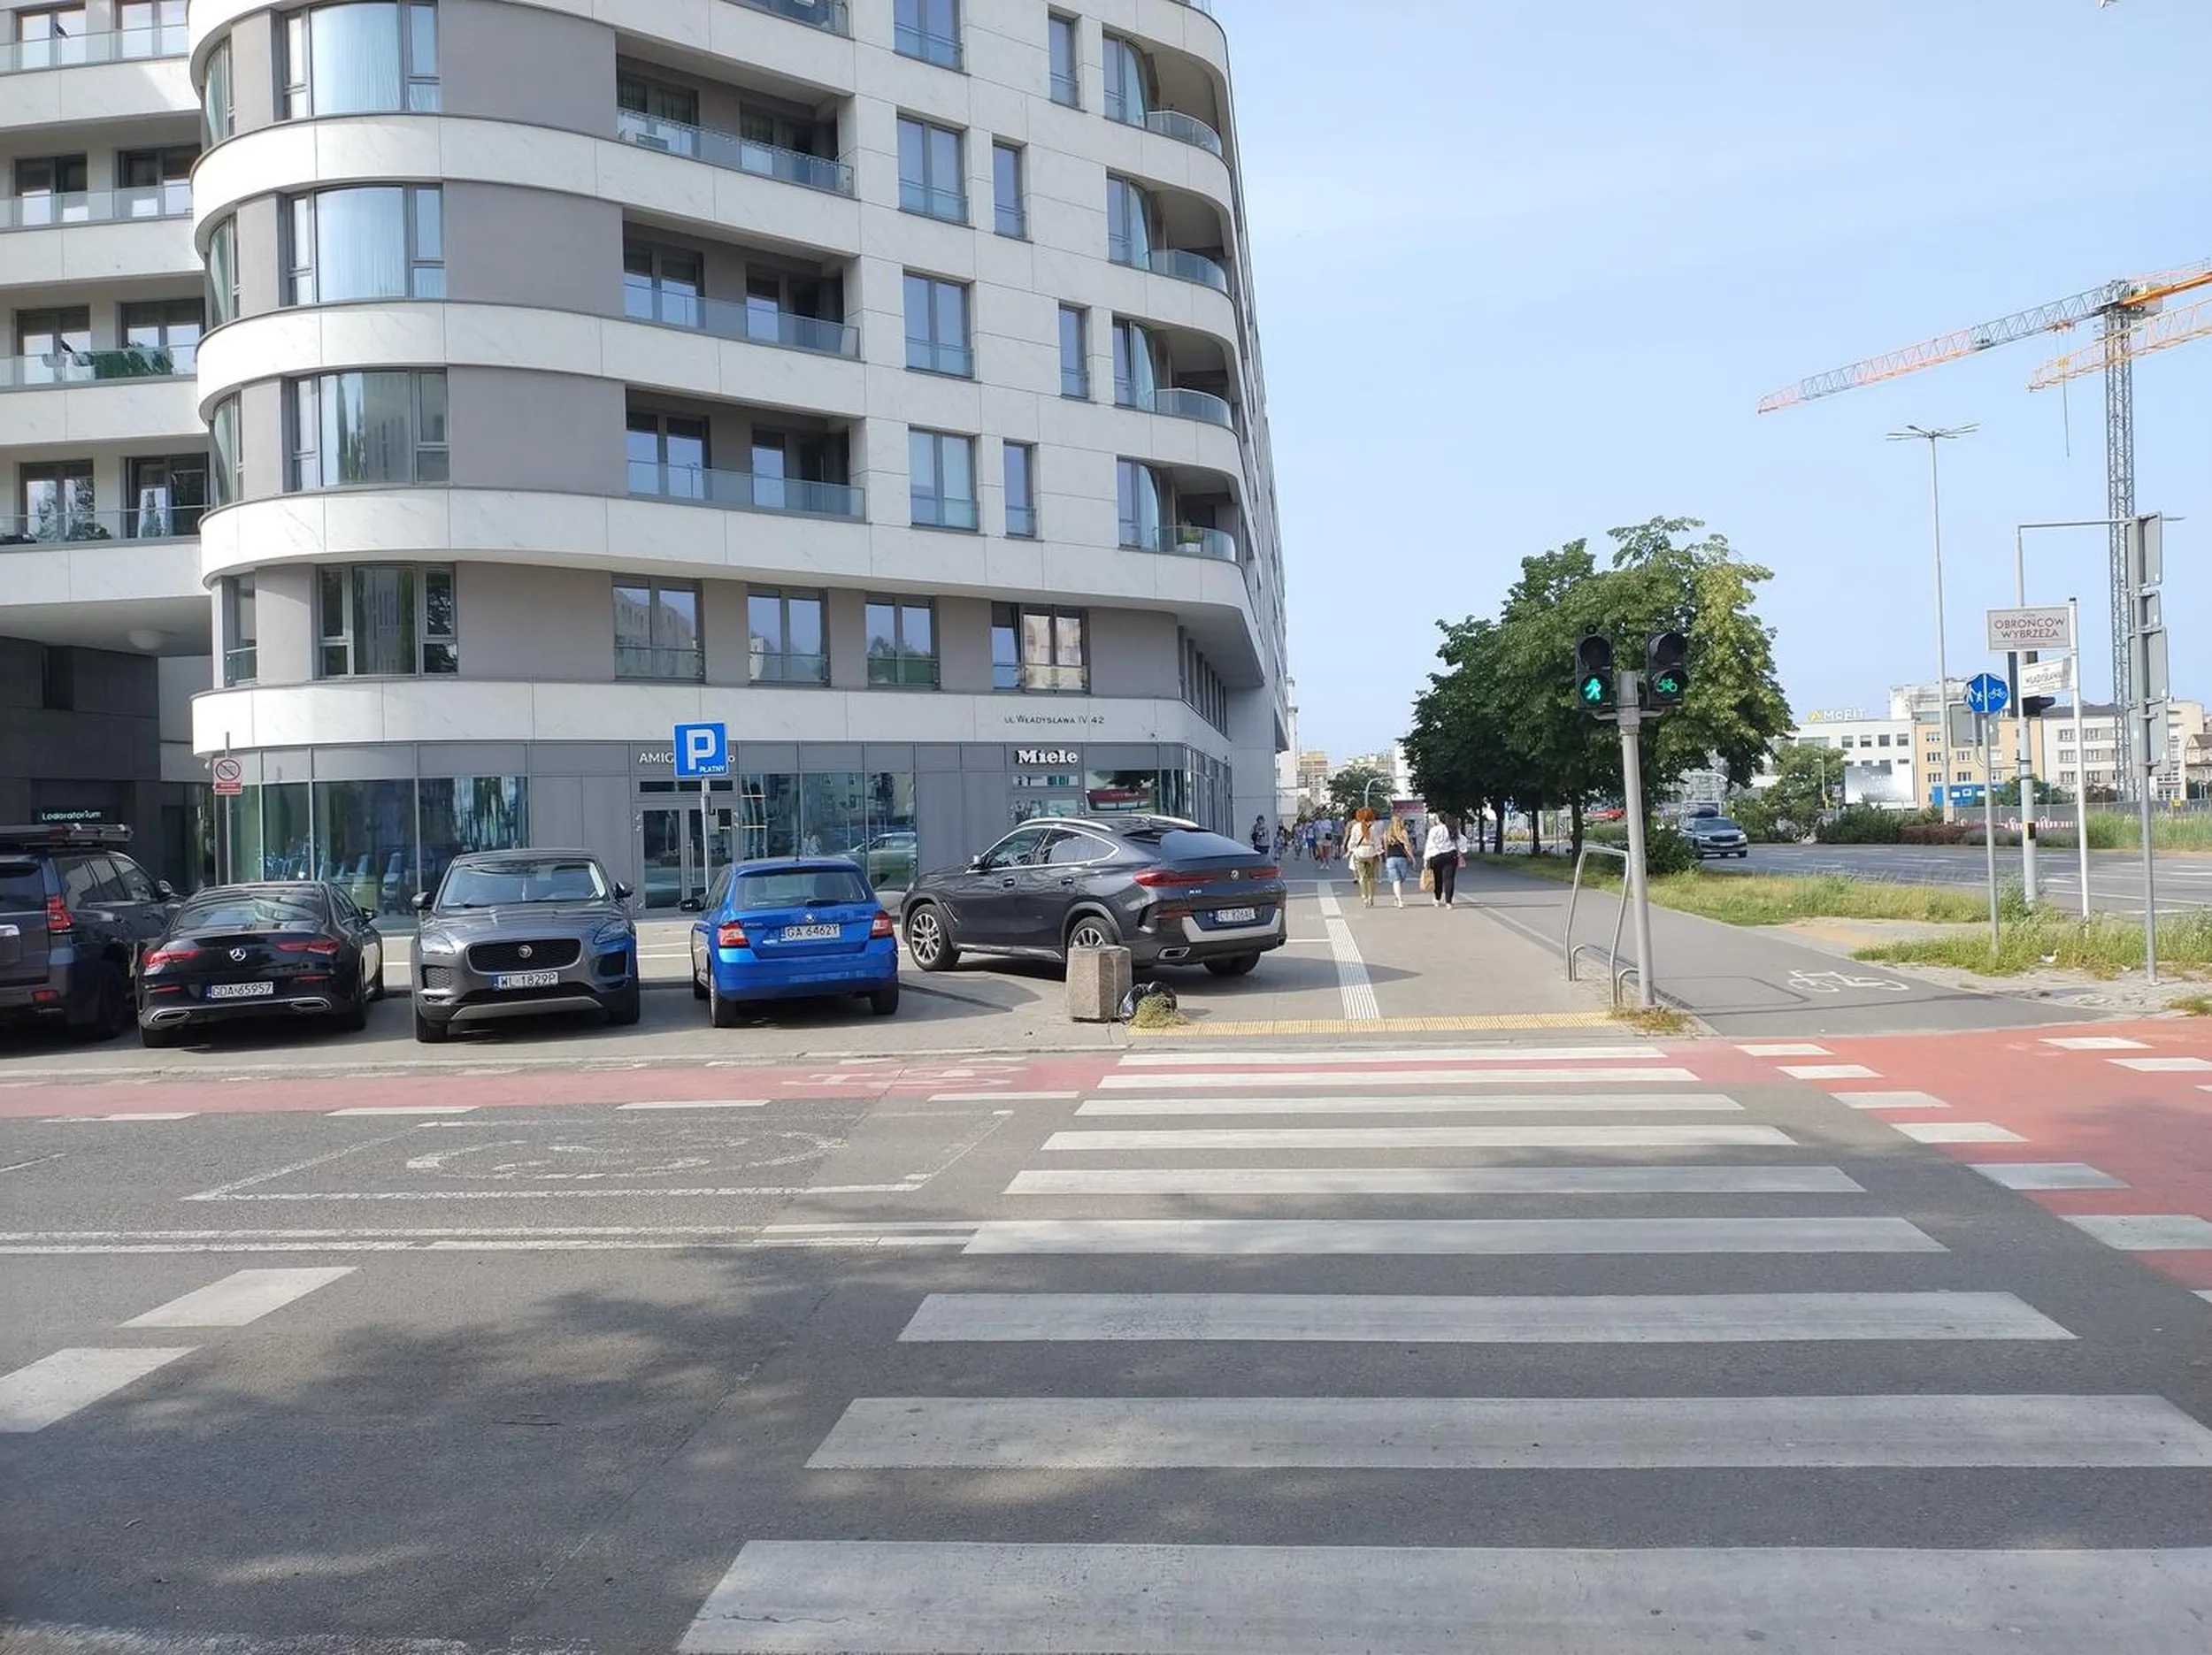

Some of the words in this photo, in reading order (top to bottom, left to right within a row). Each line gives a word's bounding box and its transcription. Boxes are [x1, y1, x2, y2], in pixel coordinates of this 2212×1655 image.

[687, 729, 716, 770] P
[1017, 749, 1078, 763] Miele
[787, 928, 803, 939] GA
[806, 924, 839, 936] 6462Y
